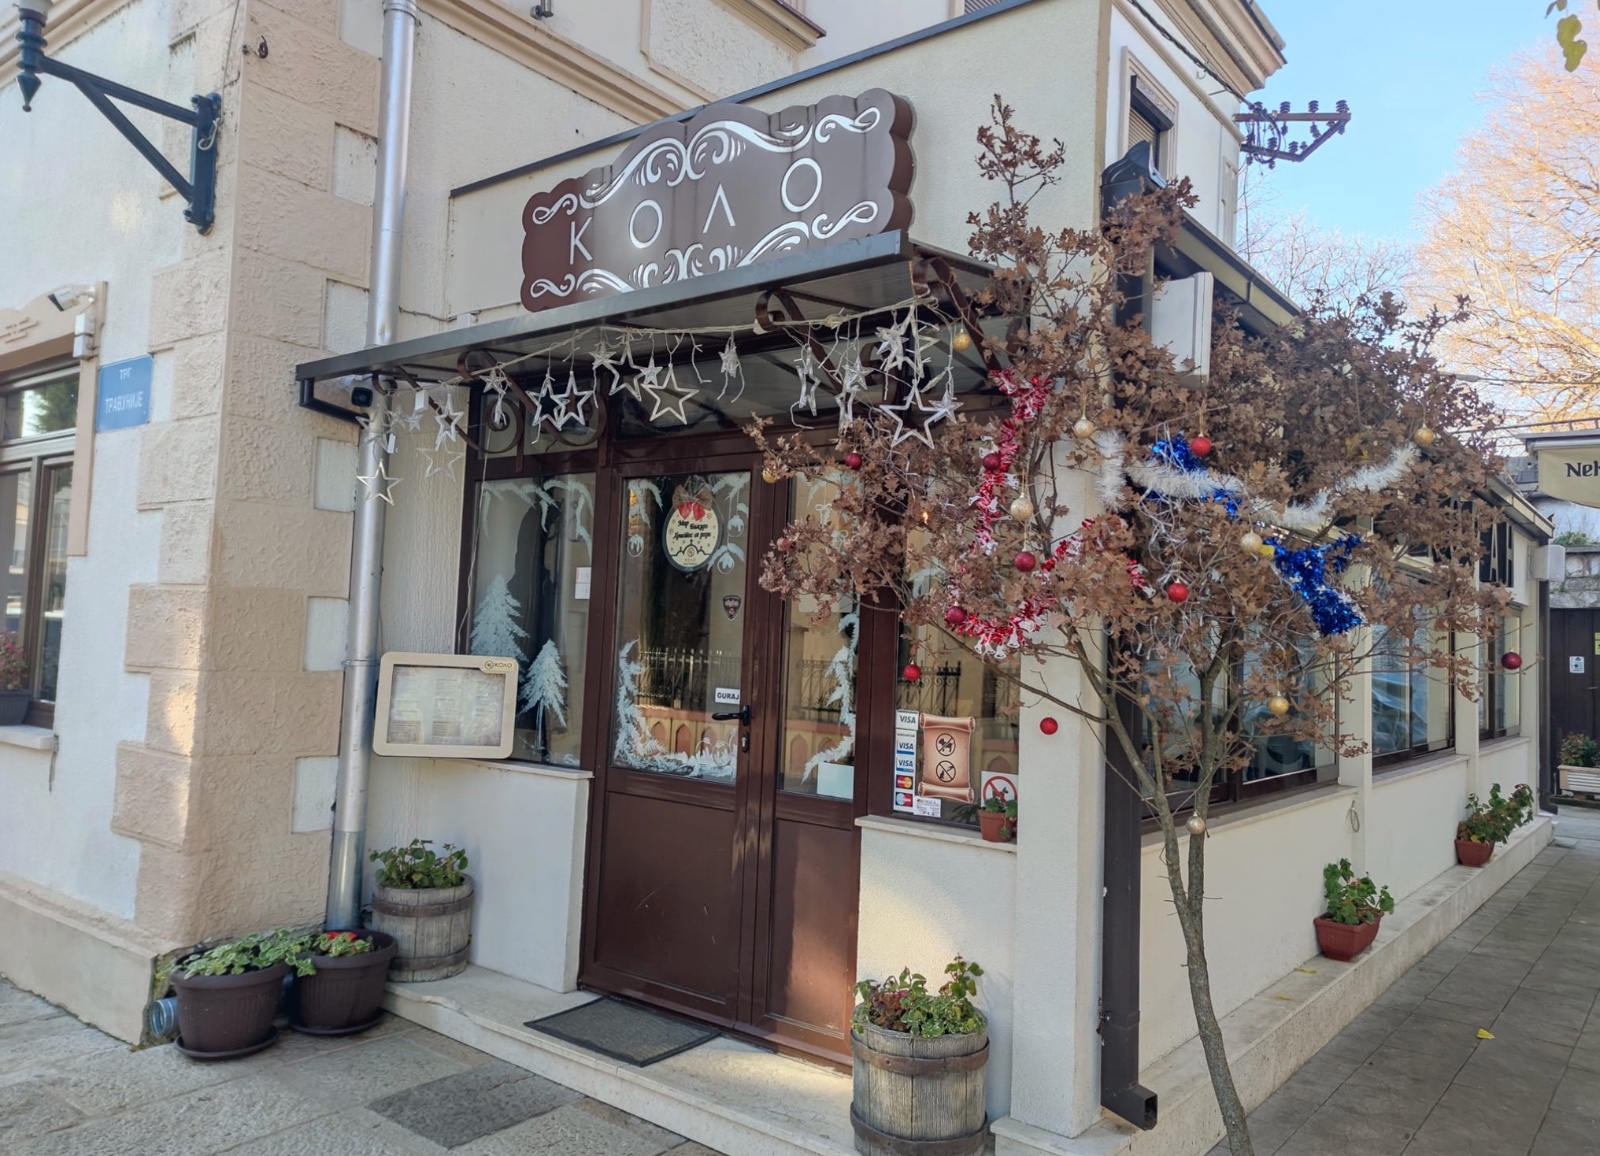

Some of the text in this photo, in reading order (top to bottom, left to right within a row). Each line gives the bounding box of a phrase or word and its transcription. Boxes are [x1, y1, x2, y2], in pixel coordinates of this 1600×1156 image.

[119, 367, 132, 380] ТРГ
[105, 391, 144, 414] ТРАВУНИЈЕ
[717, 691, 740, 701] GURAJ
[899, 715, 916, 724] VISA
[898, 741, 914, 750] VISA
[898, 759, 914, 767] VISA
